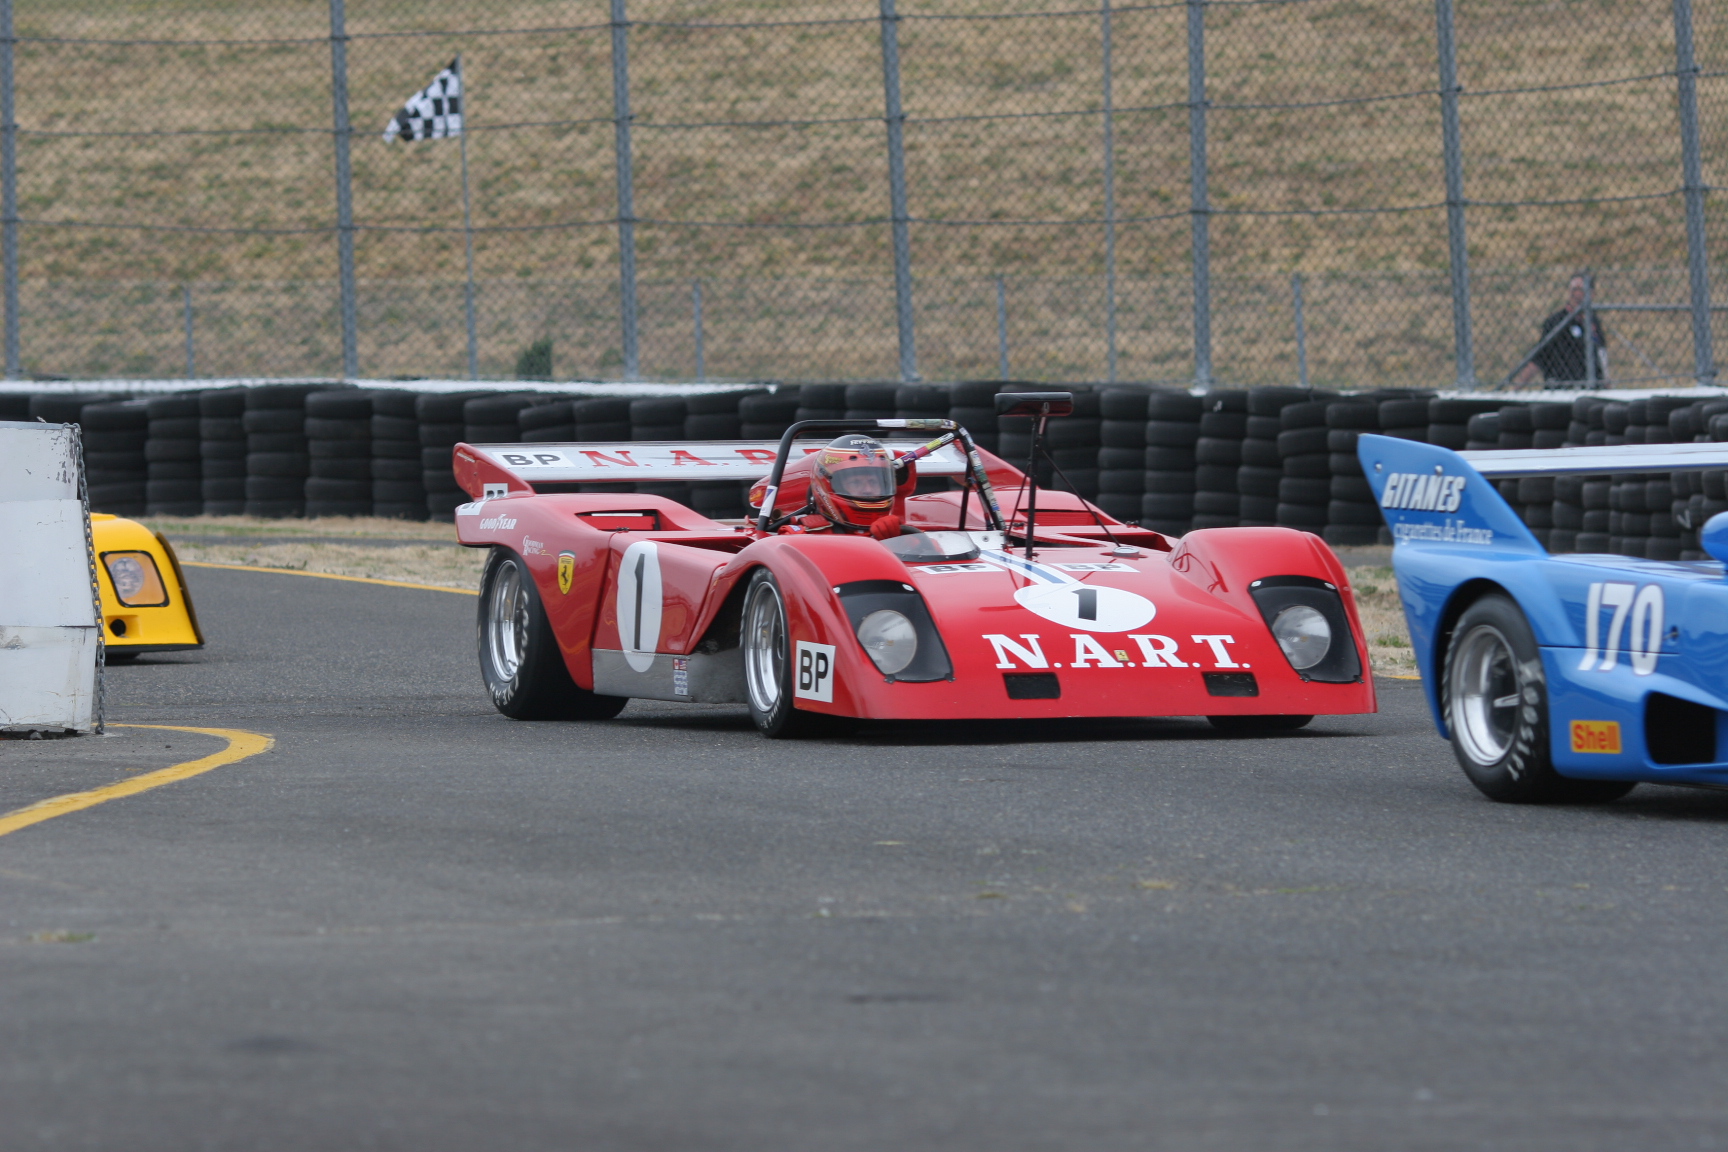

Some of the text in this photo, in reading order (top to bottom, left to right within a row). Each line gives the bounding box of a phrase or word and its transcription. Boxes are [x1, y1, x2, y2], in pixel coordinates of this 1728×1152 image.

[501, 454, 561, 466] BP
[1381, 473, 1466, 513] GITANES
[1456, 520, 1493, 544] France
[927, 563, 988, 573] BP
[1065, 563, 1121, 572] BP
[634, 553, 646, 651] 1
[1071, 588, 1098, 622] 1
[1577, 582, 1665, 676] 170
[981, 633, 1251, 669] N.A.R.T.
[799, 648, 829, 693] BP
[1573, 723, 1619, 750] Shell
